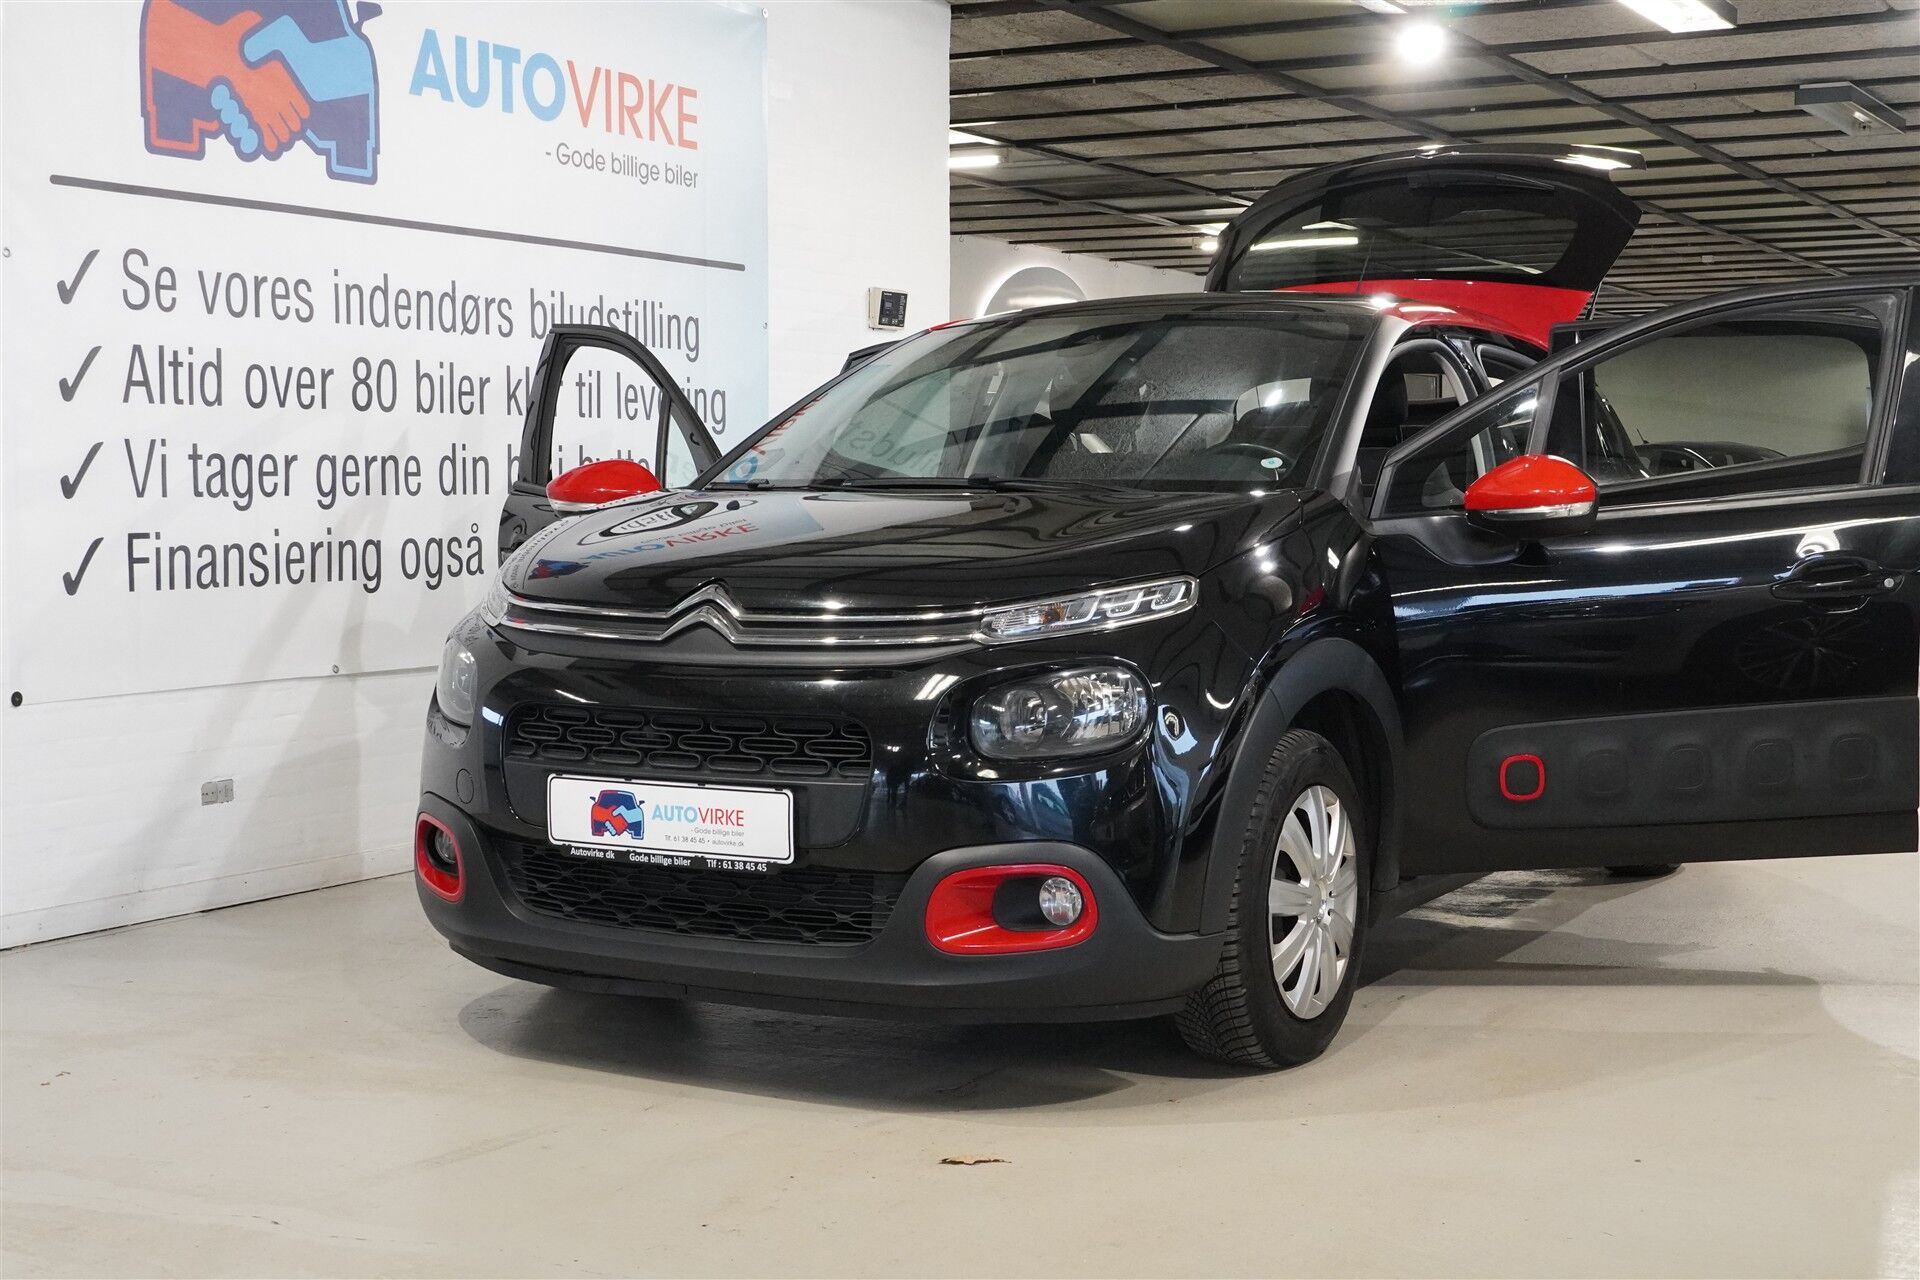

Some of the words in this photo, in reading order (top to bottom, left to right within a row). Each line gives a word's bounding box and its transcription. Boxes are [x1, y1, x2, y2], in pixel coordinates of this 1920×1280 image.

[408, 27, 699, 151] AUTOVIRKE
[555, 141, 606, 173] Gode
[610, 151, 661, 186] billige
[664, 162, 699, 189] biler
[121, 247, 178, 313] Se
[197, 269, 315, 323] vores
[332, 268, 514, 338] indendørs
[122, 343, 223, 407] Altid
[244, 363, 335, 411] over
[351, 356, 398, 413] 80
[415, 359, 491, 416] biler
[575, 369, 602, 419] til
[616, 371, 728, 436] leving
[124, 438, 169, 499] Vi
[187, 443, 299, 512] tager
[315, 450, 422, 511] gerne
[438, 442, 490, 497] din
[127, 526, 383, 595] Finansiering
[400, 522, 485, 591] også
[651, 804, 745, 826] AUTOVIRKE
[570, 846, 605, 859] Autovirke
[629, 852, 650, 863] Gode
[650, 854, 673, 867] billige
[673, 856, 691, 867] biler
[722, 860, 733, 870] 61
[734, 861, 744, 871] 38
[745, 862, 755, 872] 45
[756, 863, 768, 873] 45
